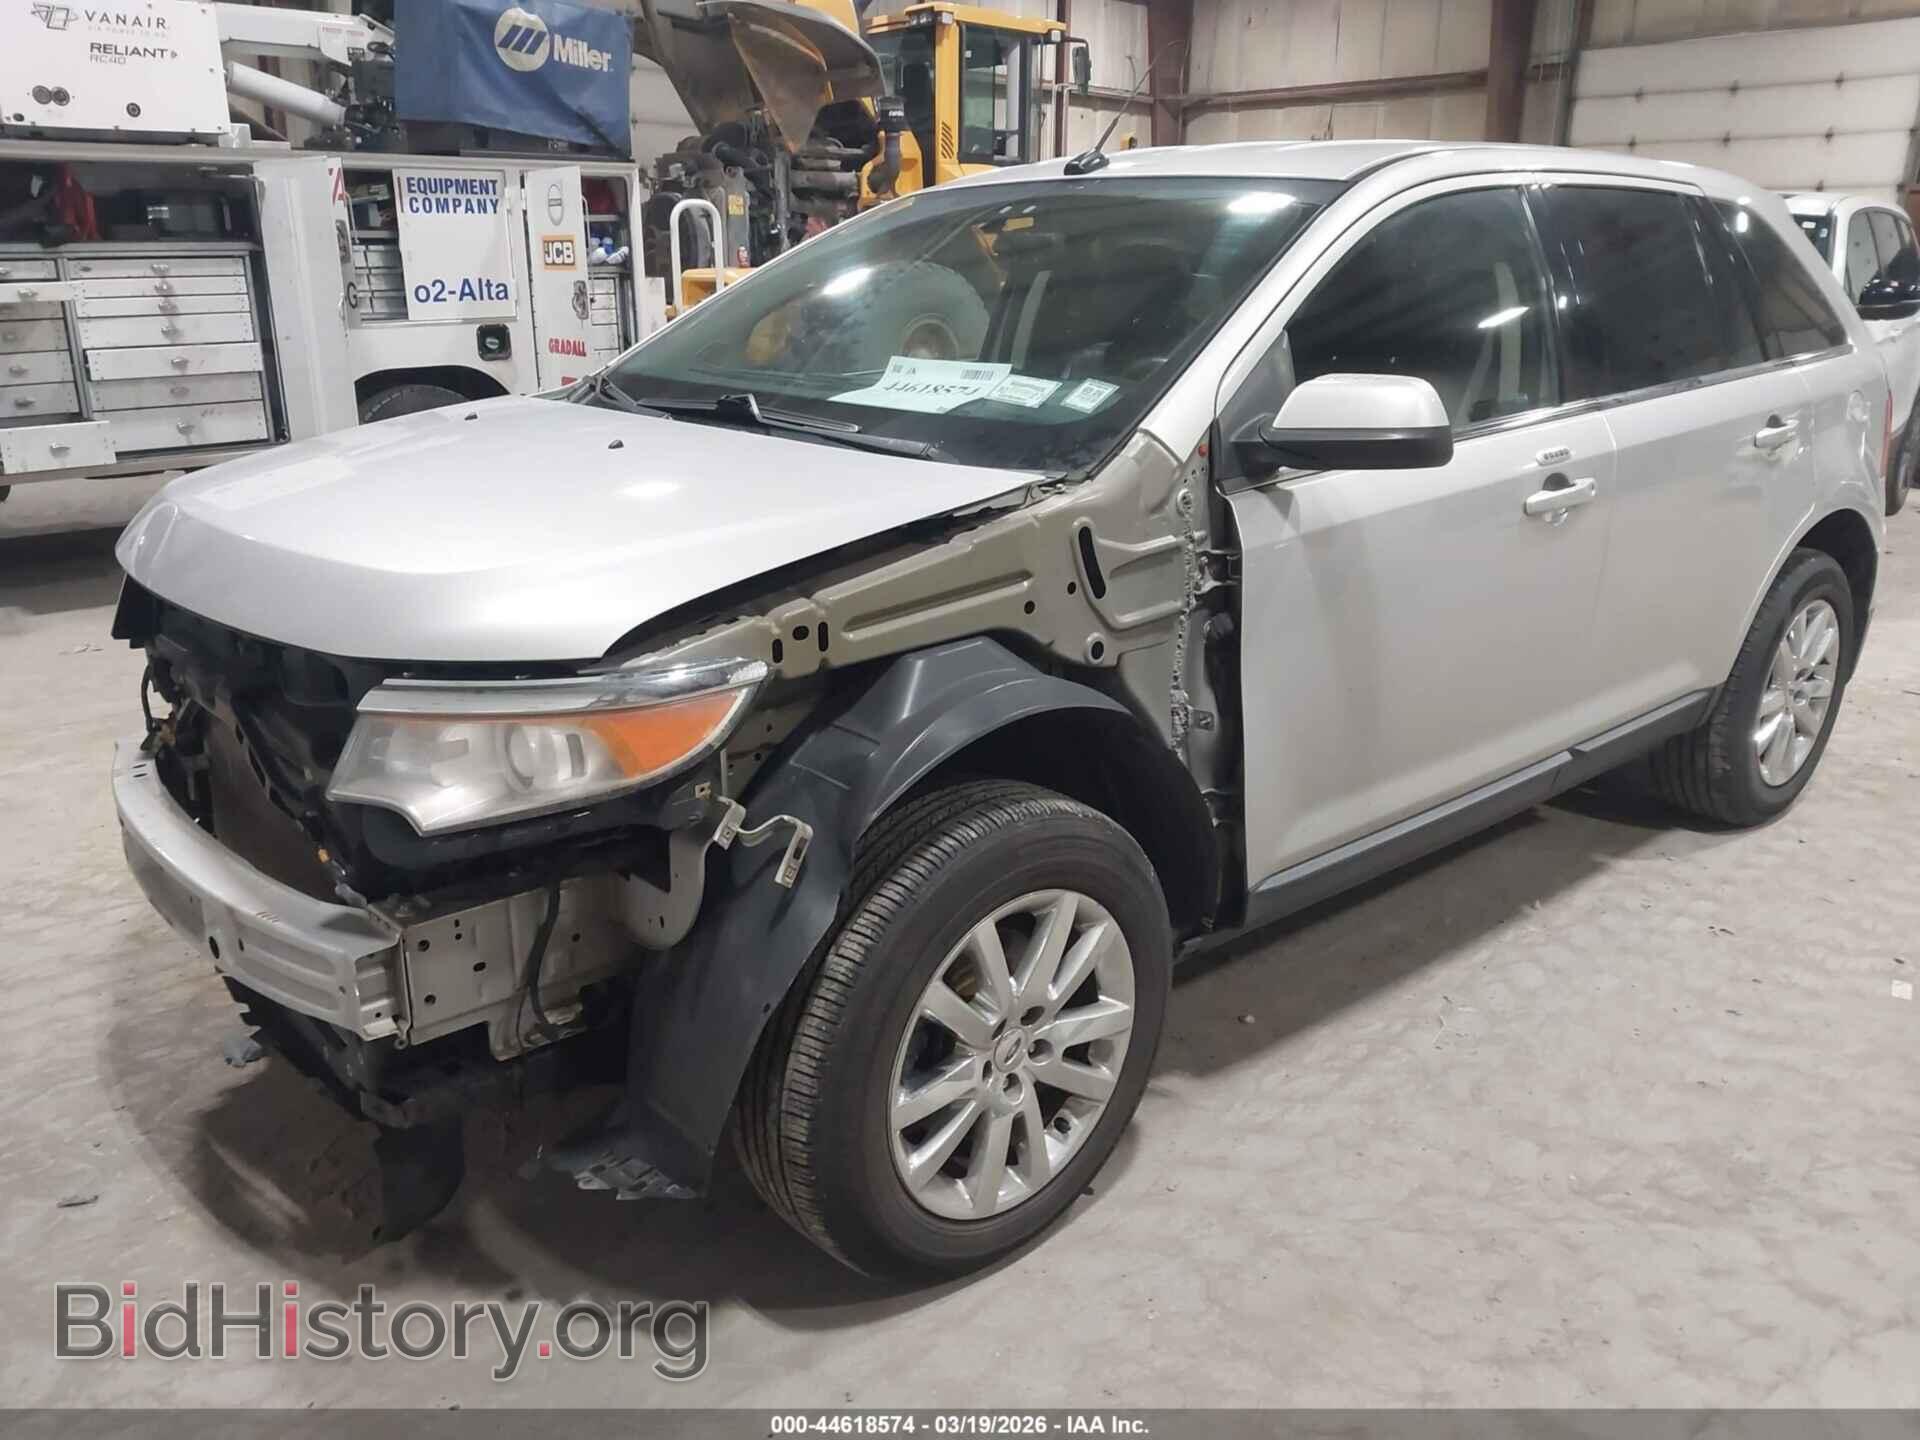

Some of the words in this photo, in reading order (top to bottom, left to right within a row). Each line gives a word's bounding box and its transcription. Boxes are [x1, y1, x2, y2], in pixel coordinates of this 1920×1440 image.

[84, 9, 167, 30] VANAIR
[90, 42, 168, 59] RELIANT
[553, 33, 612, 73] Miller
[406, 176, 498, 196] EQUIPMENT
[409, 196, 499, 214] COMPANY
[544, 241, 574, 264] JCB
[414, 278, 509, 303] o2-Alta
[549, 338, 587, 357] GRADALL
